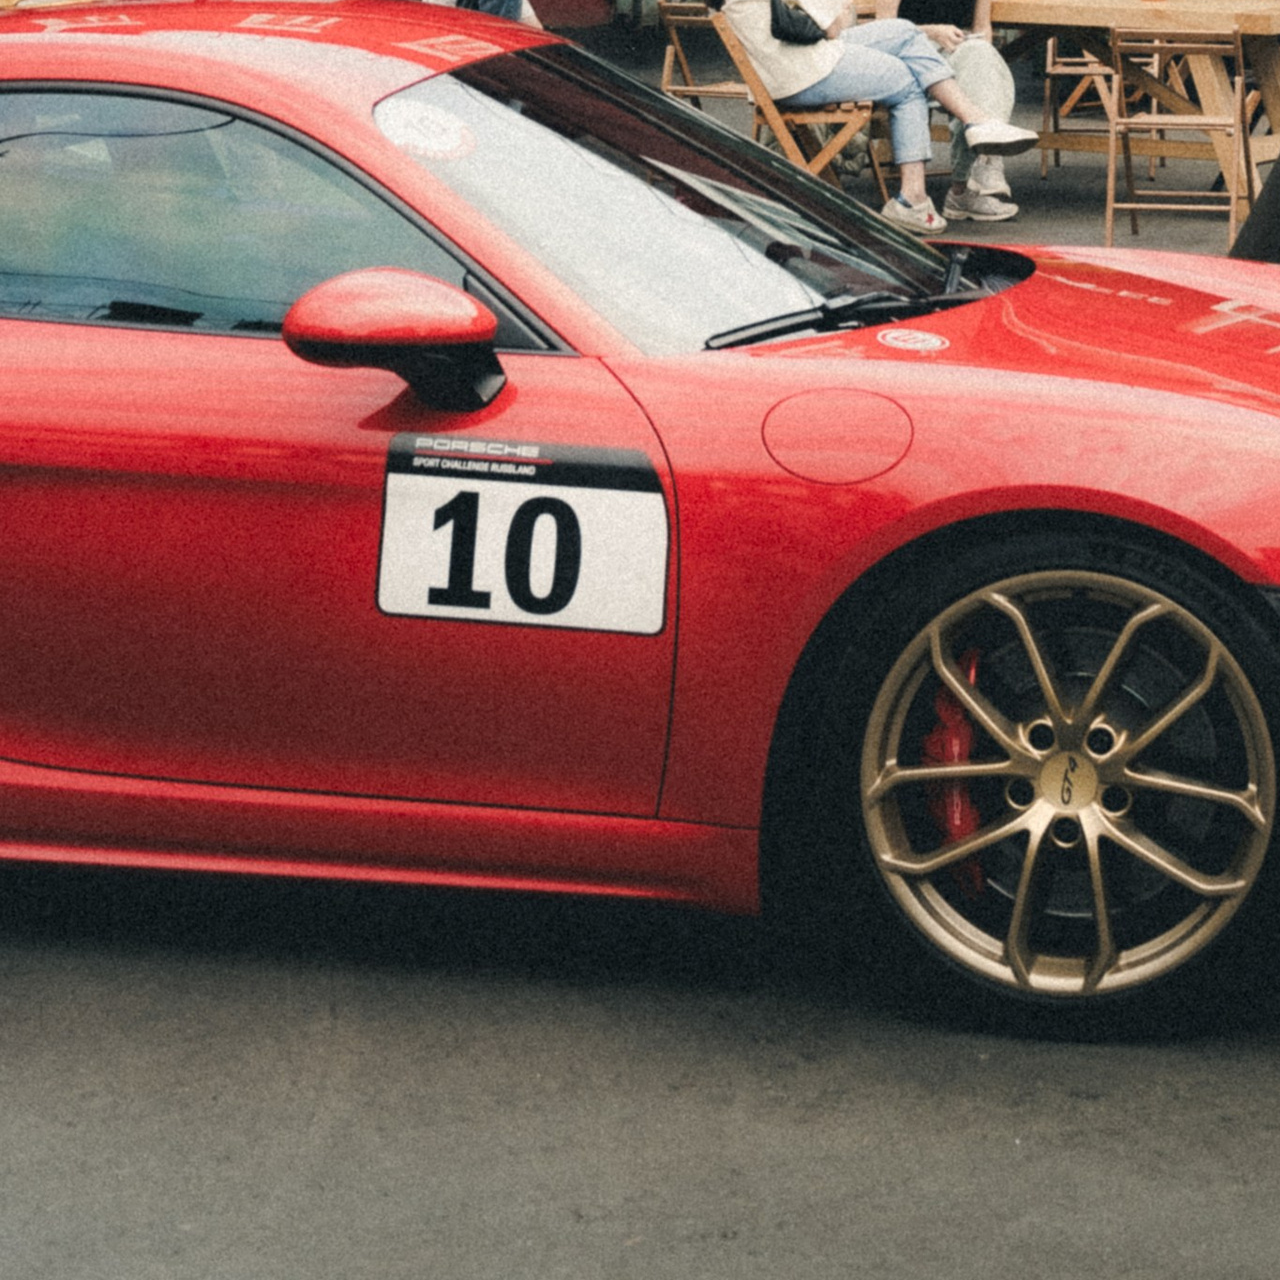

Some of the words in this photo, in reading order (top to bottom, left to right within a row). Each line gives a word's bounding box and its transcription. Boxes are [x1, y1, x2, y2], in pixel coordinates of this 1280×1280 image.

[412, 457, 440, 468] SPORT
[415, 437, 540, 458] PORSCHE
[427, 490, 582, 616] 10
[1061, 755, 1078, 805] GT4
